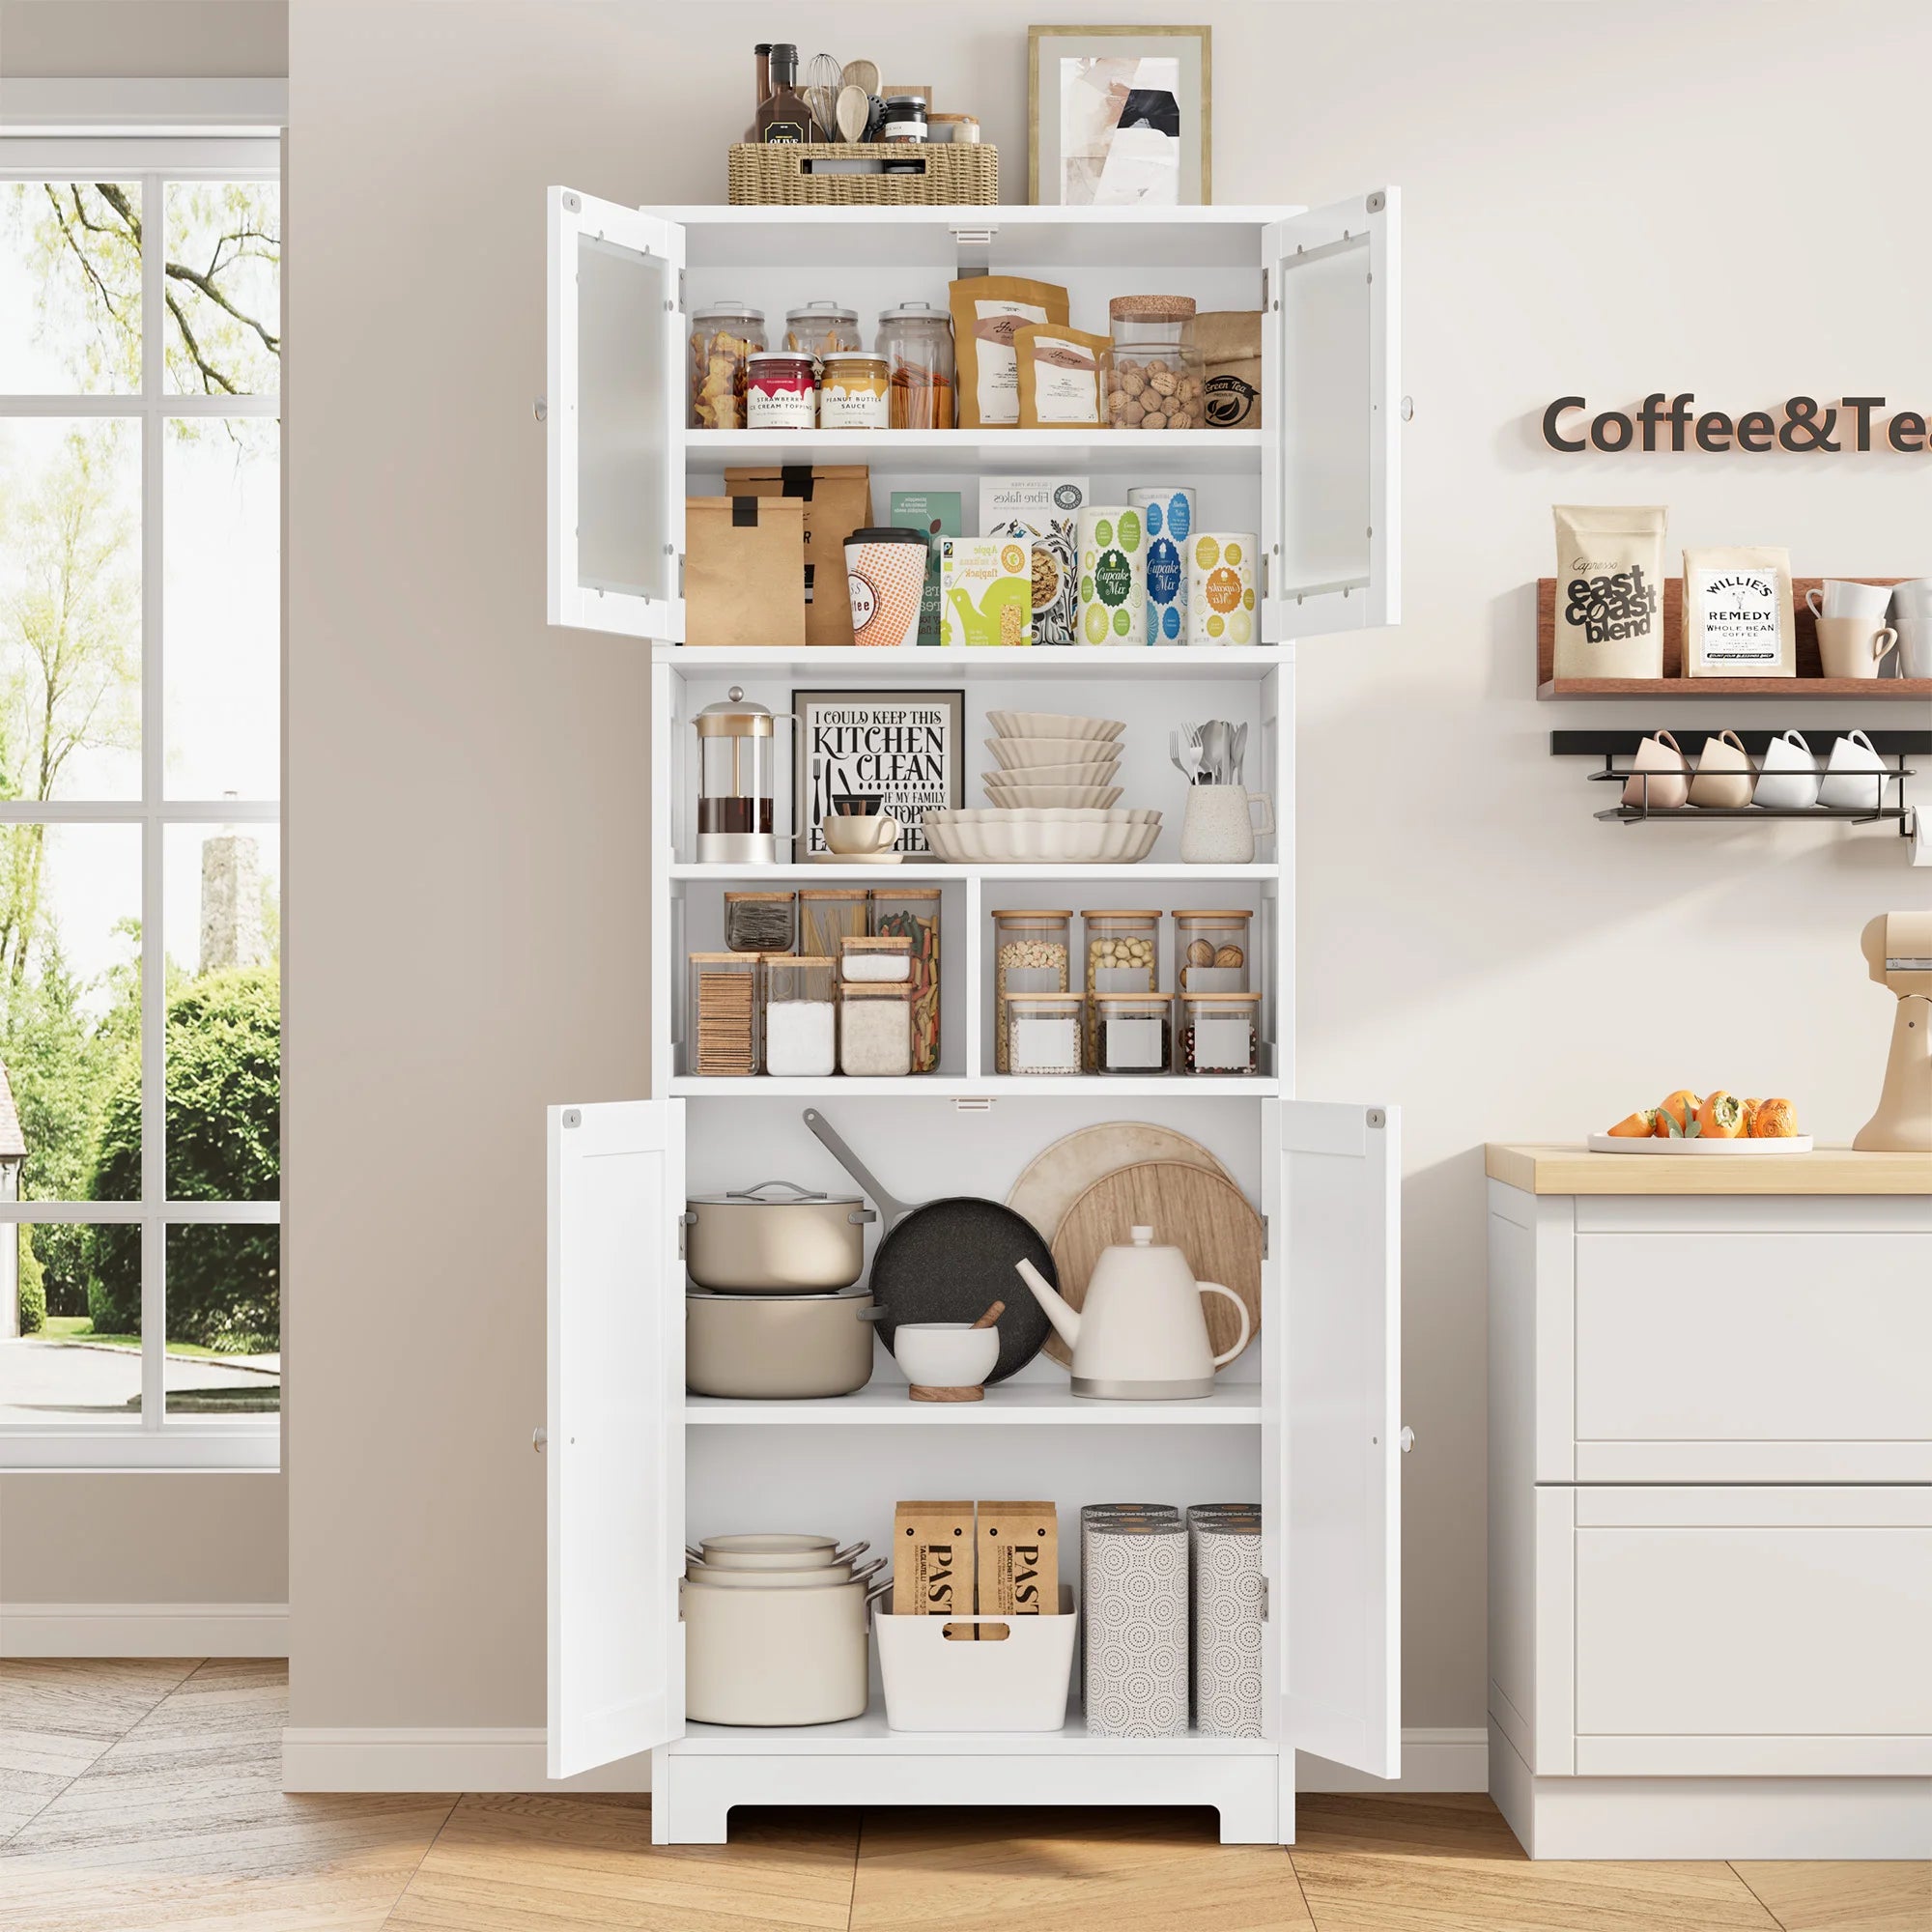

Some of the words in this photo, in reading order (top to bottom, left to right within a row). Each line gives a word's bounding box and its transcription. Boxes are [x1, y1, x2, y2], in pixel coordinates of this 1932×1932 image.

[1205, 382, 1229, 392] Green
[1232, 381, 1246, 392] Tea
[1543, 392, 1932, 453] Coffee&Te
[1096, 566, 1129, 584] Cupcake
[1147, 557, 1179, 575] Cupcake
[1105, 581, 1126, 596] Mix
[1155, 574, 1176, 591] Mix
[1567, 564, 1645, 604] east
[1706, 576, 1773, 597] WILLIE'S
[1565, 583, 1658, 626] coast
[1709, 611, 1771, 620] REMEDY
[1584, 611, 1651, 643] blend
[1746, 623, 1775, 632] BEAN
[814, 710, 820, 724] I
[823, 710, 868, 725] COULD
[872, 710, 907, 725] KEEP
[909, 710, 942, 725] THIS
[812, 725, 946, 760] KITCHEN
[856, 753, 946, 781] CLEAN
[884, 791, 894, 803] IF
[895, 791, 911, 803] MY
[912, 791, 947, 803] FAMILY
